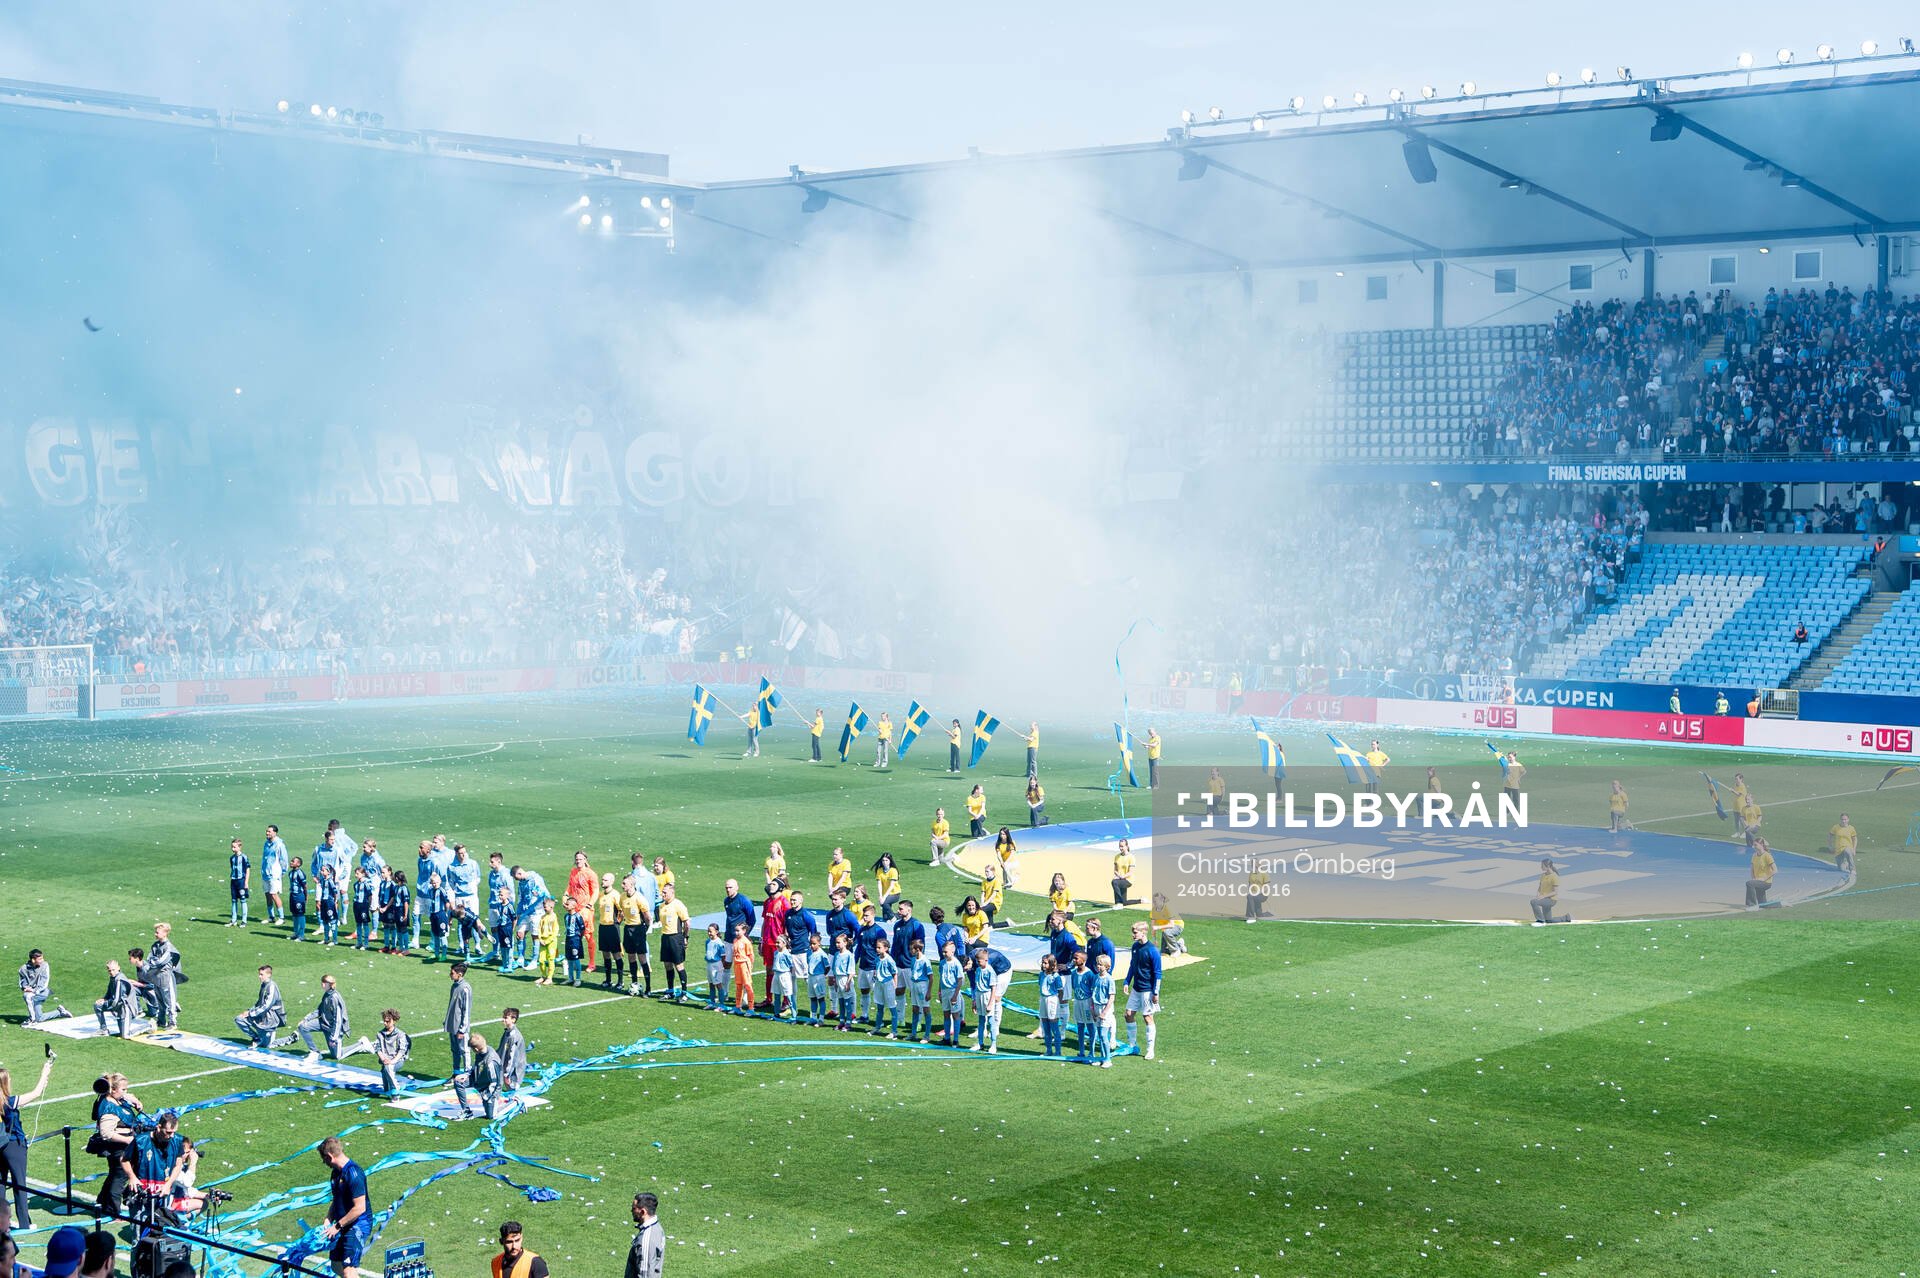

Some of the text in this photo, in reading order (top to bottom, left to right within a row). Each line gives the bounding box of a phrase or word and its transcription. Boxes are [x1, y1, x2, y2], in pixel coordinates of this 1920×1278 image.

[1549, 465, 1687, 481] FINAL SVENSKA CUPEN
[120, 696, 161, 708] EKSJÖHUS
[1445, 683, 1614, 708] SVKA CUPEN
[1475, 707, 1516, 727] AUS
[1658, 719, 1703, 738] AUS
[1862, 729, 1911, 751] AUS
